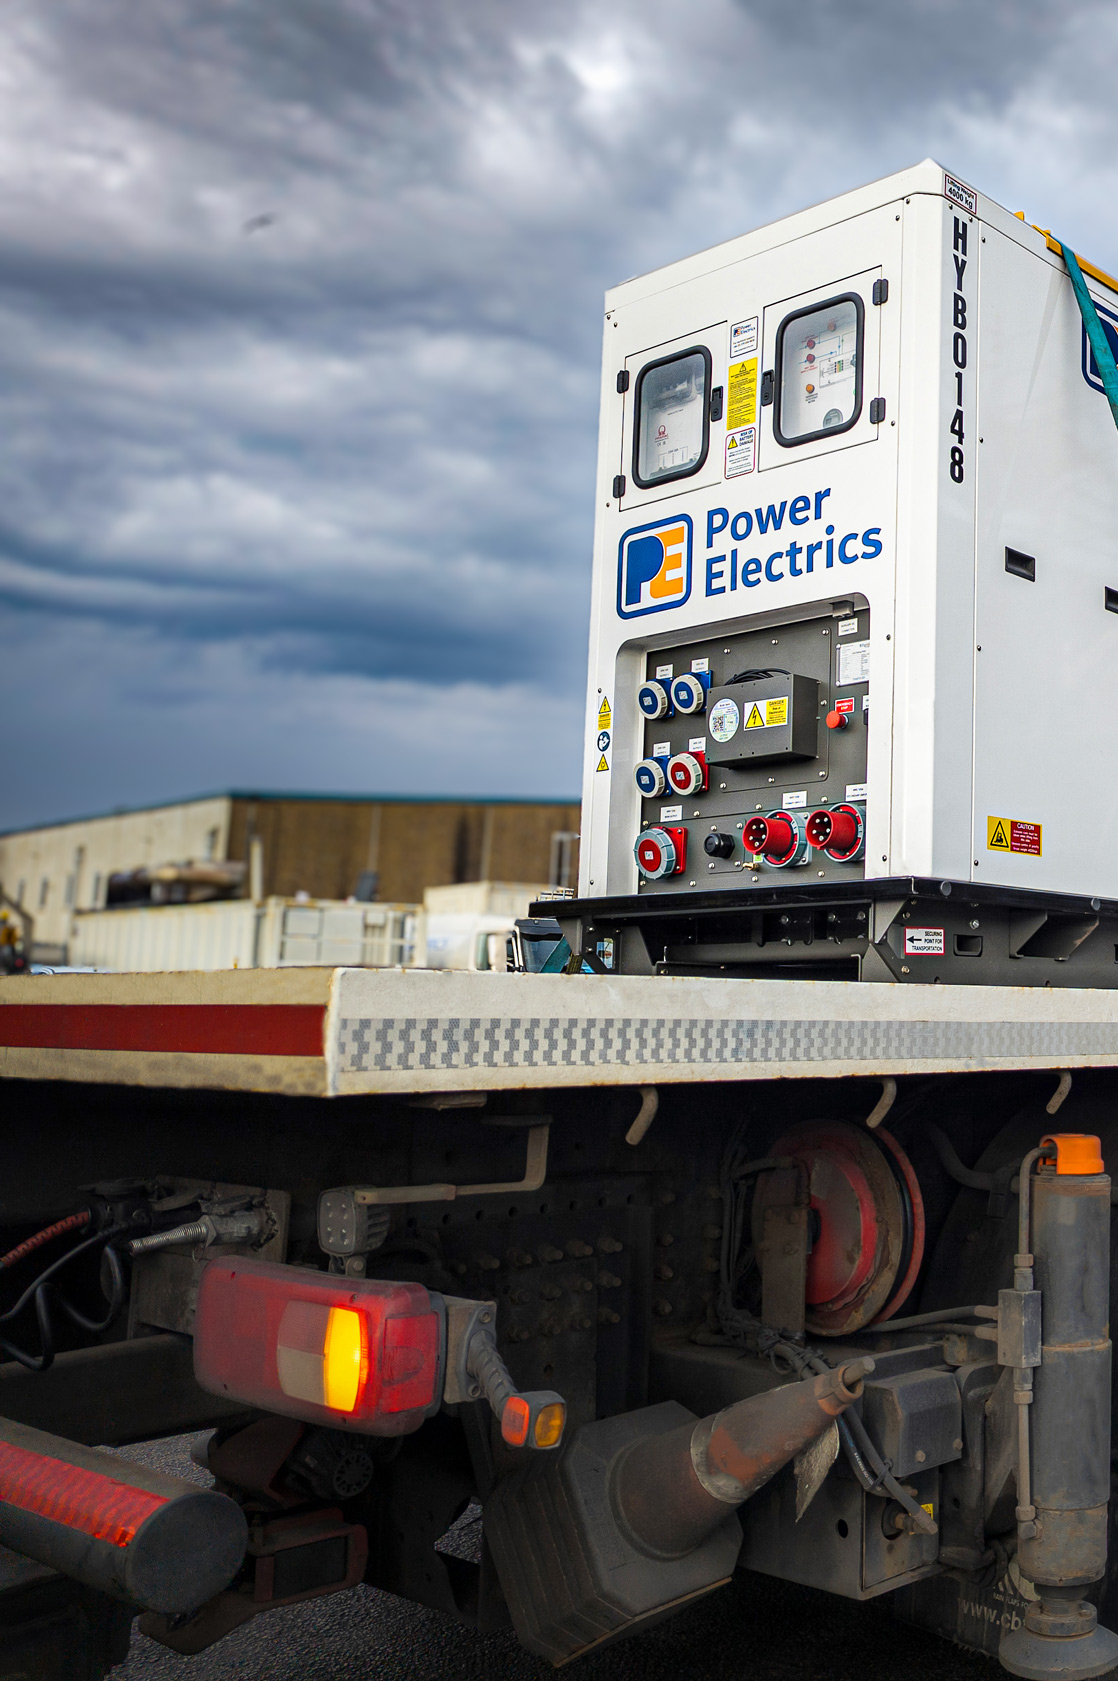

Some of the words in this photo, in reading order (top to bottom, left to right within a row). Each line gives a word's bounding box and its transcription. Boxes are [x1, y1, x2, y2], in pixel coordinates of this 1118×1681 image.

[948, 187, 964, 202] 4000
[965, 196, 973, 209] kg
[706, 487, 831, 548] Power
[705, 526, 883, 598] Electrics
